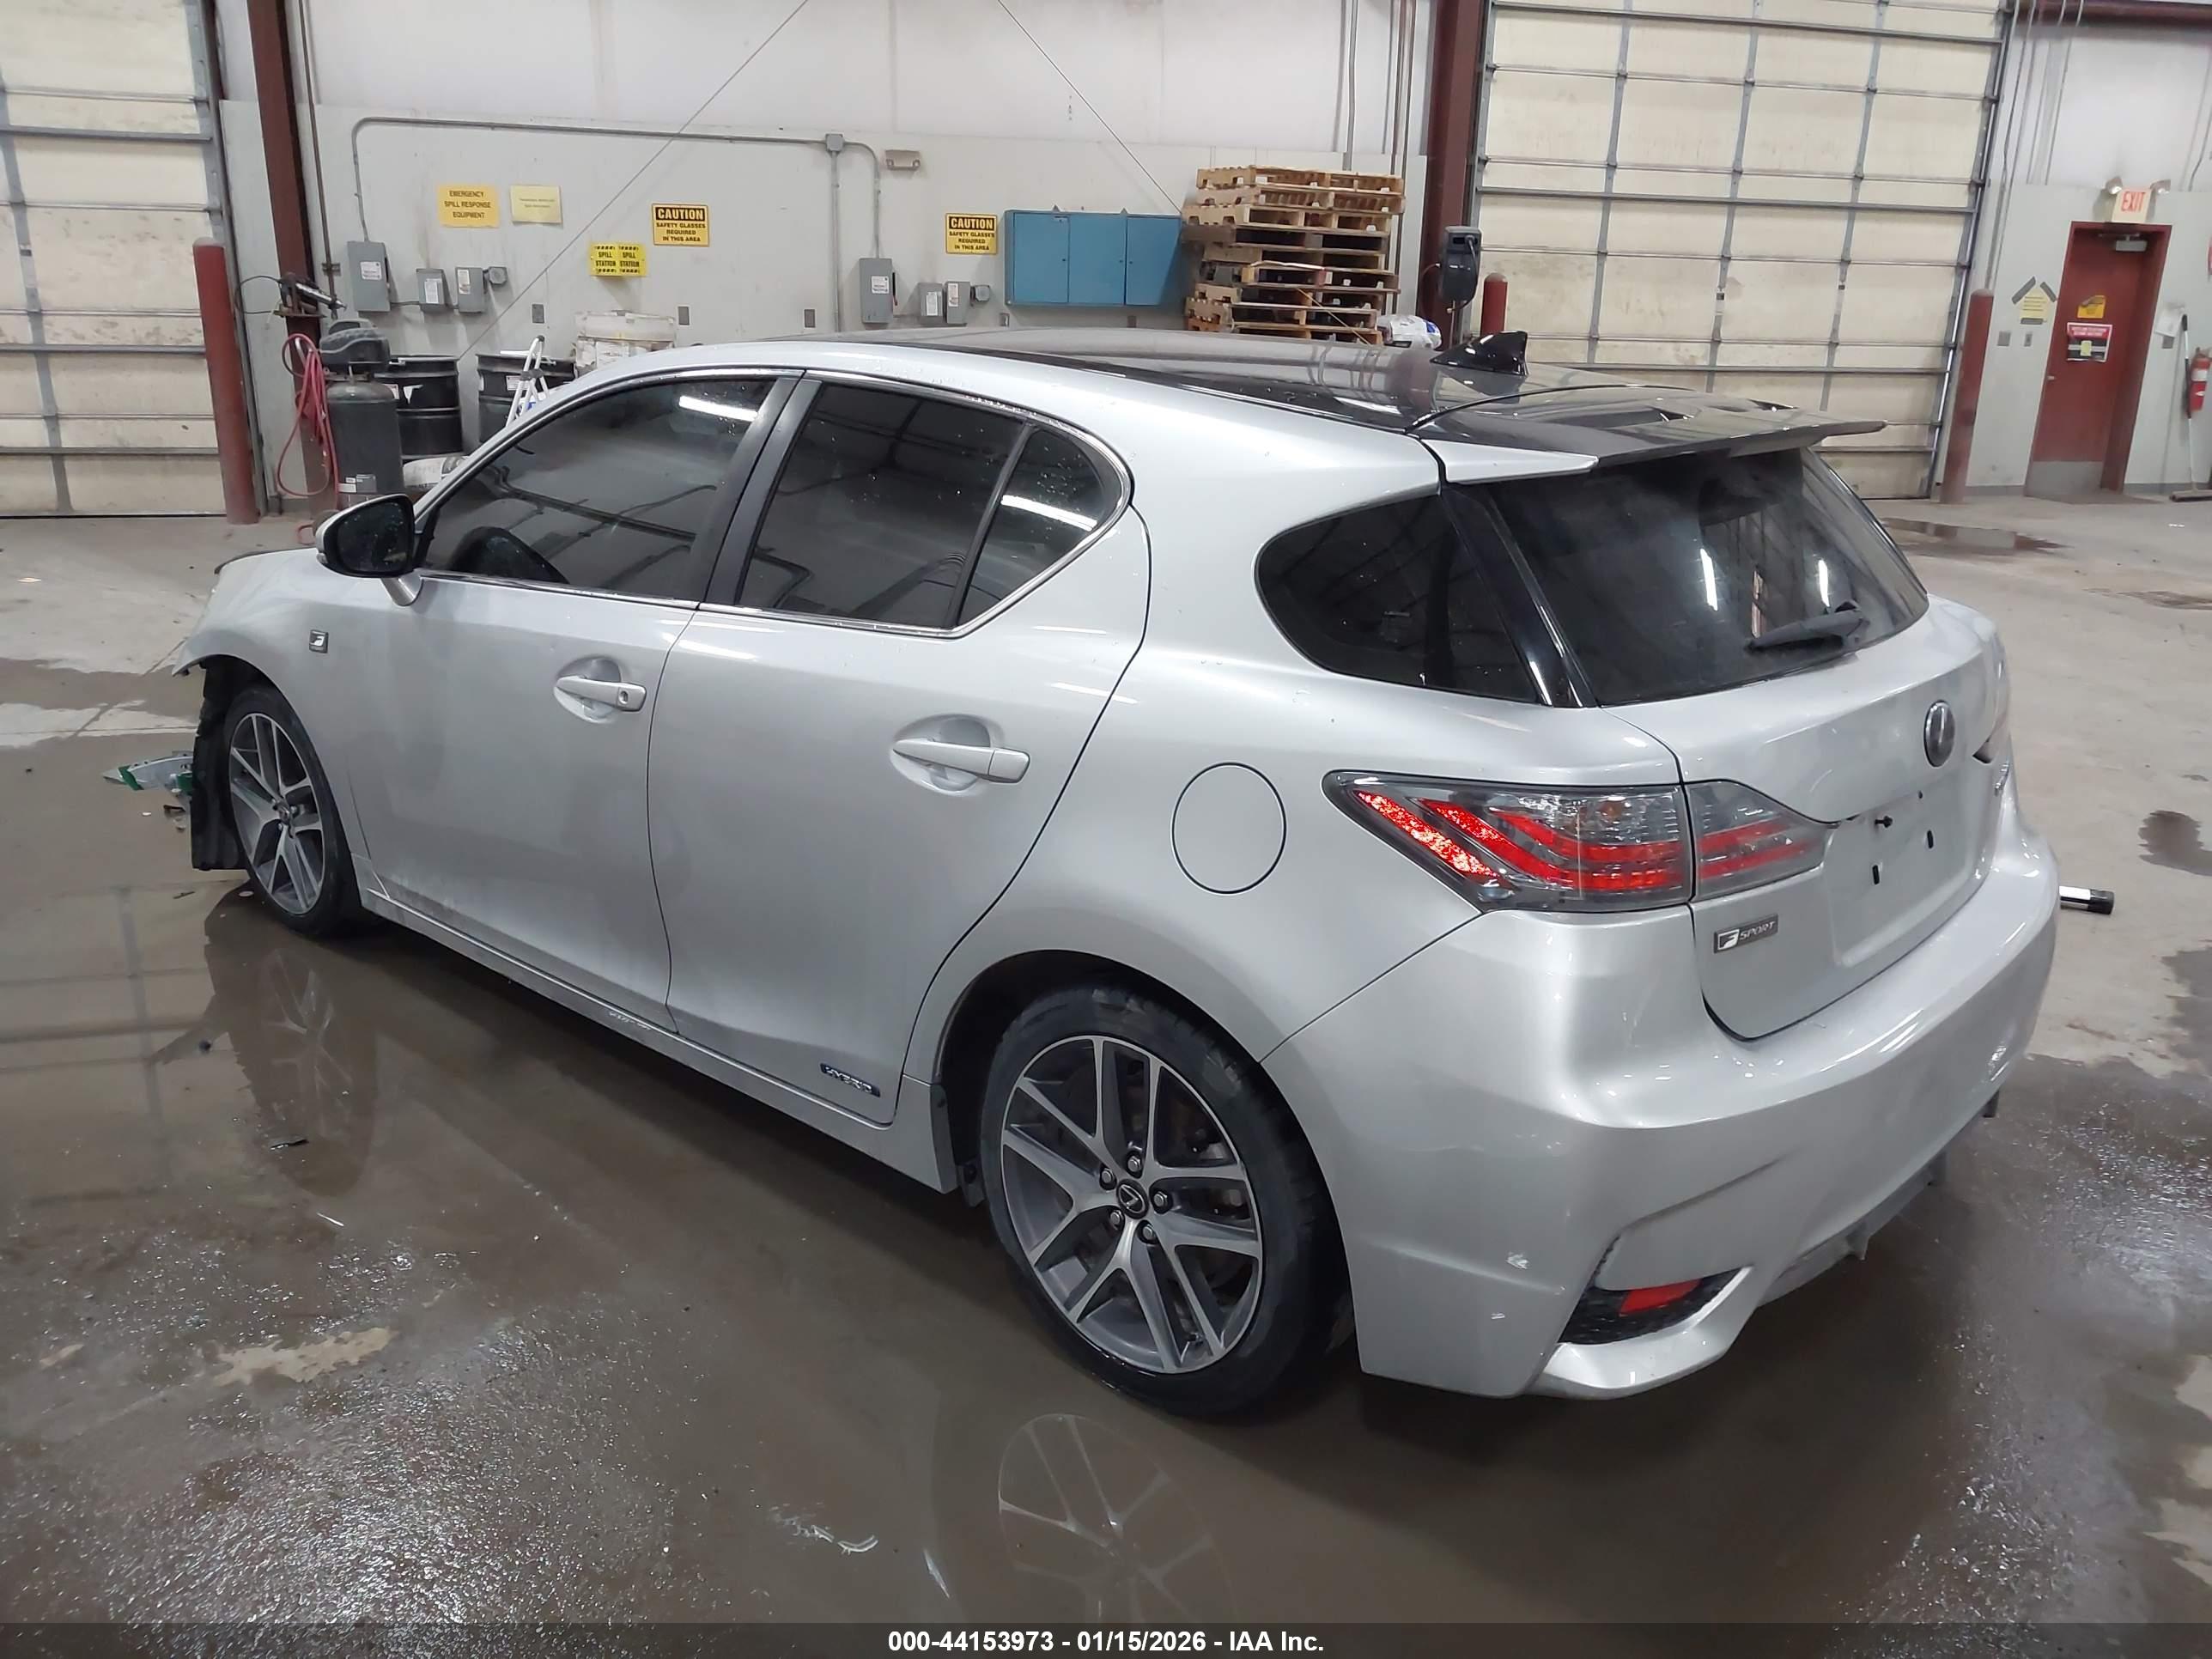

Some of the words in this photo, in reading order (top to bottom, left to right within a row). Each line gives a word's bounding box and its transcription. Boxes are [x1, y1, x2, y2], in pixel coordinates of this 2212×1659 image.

[2121, 191, 2146, 212] EXIT
[658, 208, 704, 221] CAUTION
[951, 217, 994, 230] CAUTION
[1739, 921, 1776, 941] SPORT
